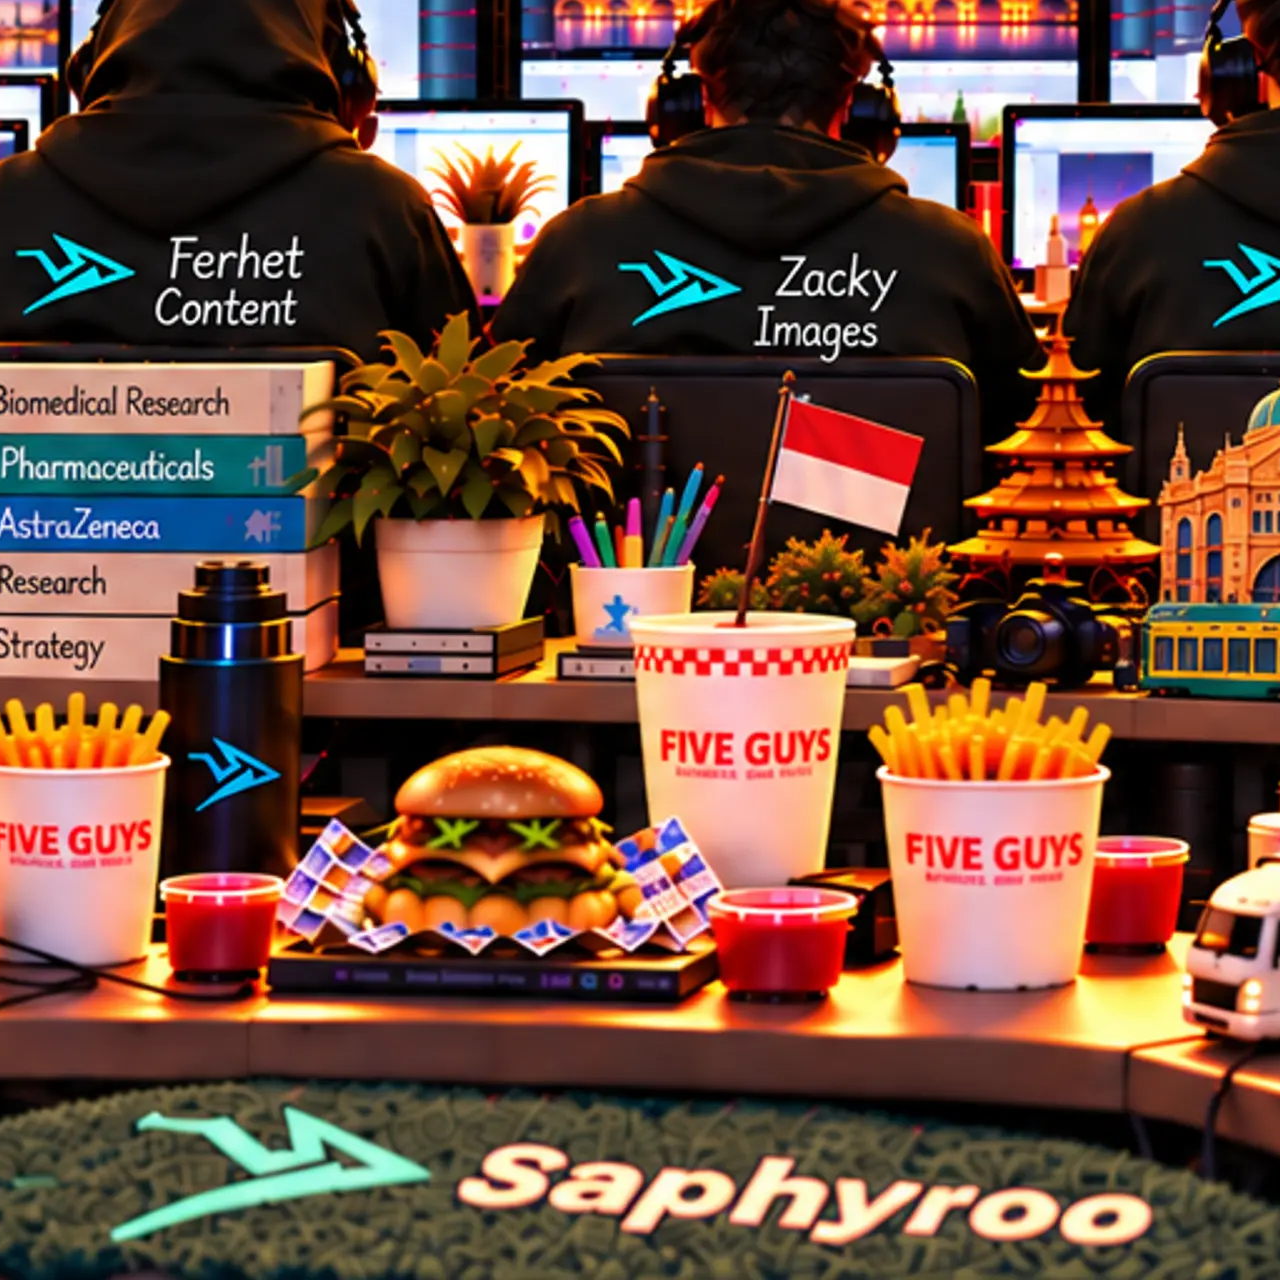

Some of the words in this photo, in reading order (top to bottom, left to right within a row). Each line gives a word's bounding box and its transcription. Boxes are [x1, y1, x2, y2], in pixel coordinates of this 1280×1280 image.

[171, 233, 303, 278] Ferhet
[776, 253, 896, 311] Zacky
[156, 288, 297, 325] Content
[754, 306, 877, 362] Images
[127, 386, 229, 416] Research
[1, 446, 214, 480] Pharmaceuticals
[661, 730, 734, 765] FIVE
[745, 728, 830, 765] GUYS
[69, 820, 151, 854] GUYS
[906, 833, 982, 870] FIVE
[994, 833, 1082, 870] GUYS
[459, 1145, 1151, 1243] Saphyroo
